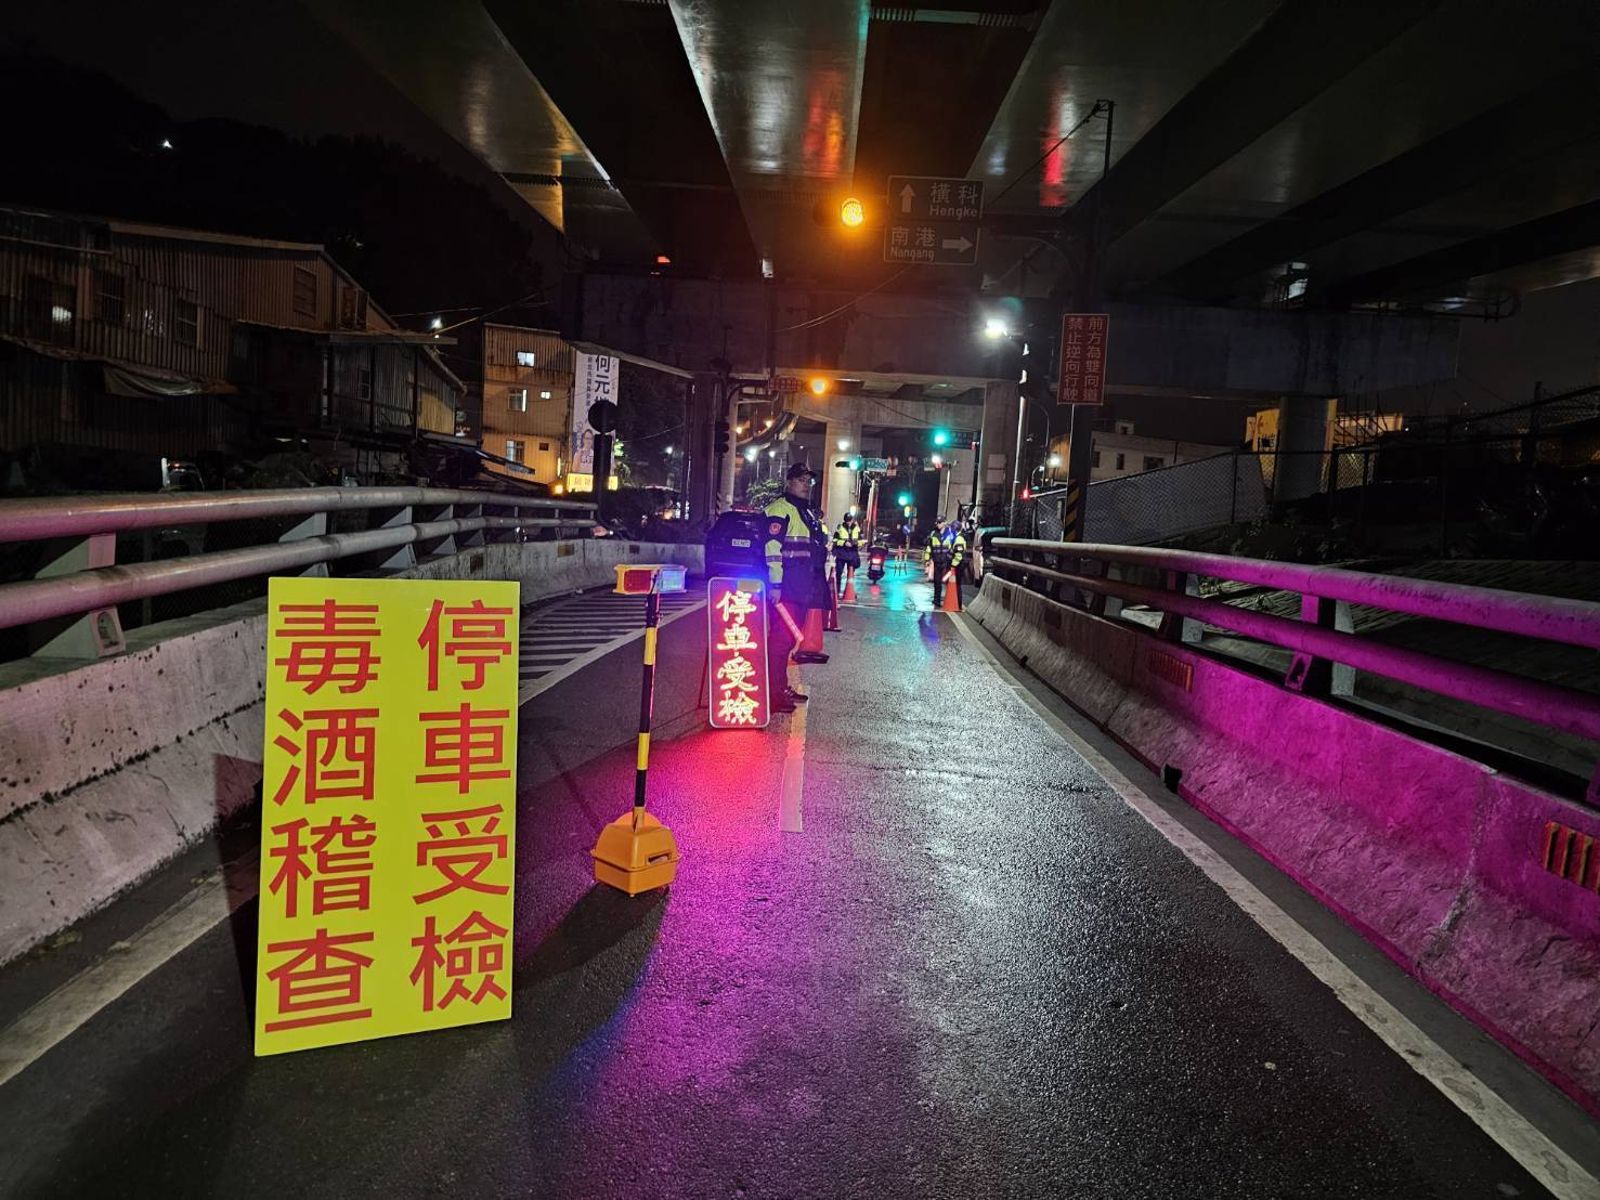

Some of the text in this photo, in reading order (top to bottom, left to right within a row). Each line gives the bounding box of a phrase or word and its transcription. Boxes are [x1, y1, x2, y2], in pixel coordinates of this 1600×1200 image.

[891, 225, 936, 247] 南港
[929, 204, 978, 221] Hengke
[890, 246, 936, 262] Nangang
[594, 354, 611, 403] 何元
[715, 590, 760, 725] 停車受檢
[264, 598, 381, 1033] 毒酒稽查
[410, 598, 514, 1012] 停車受檢
